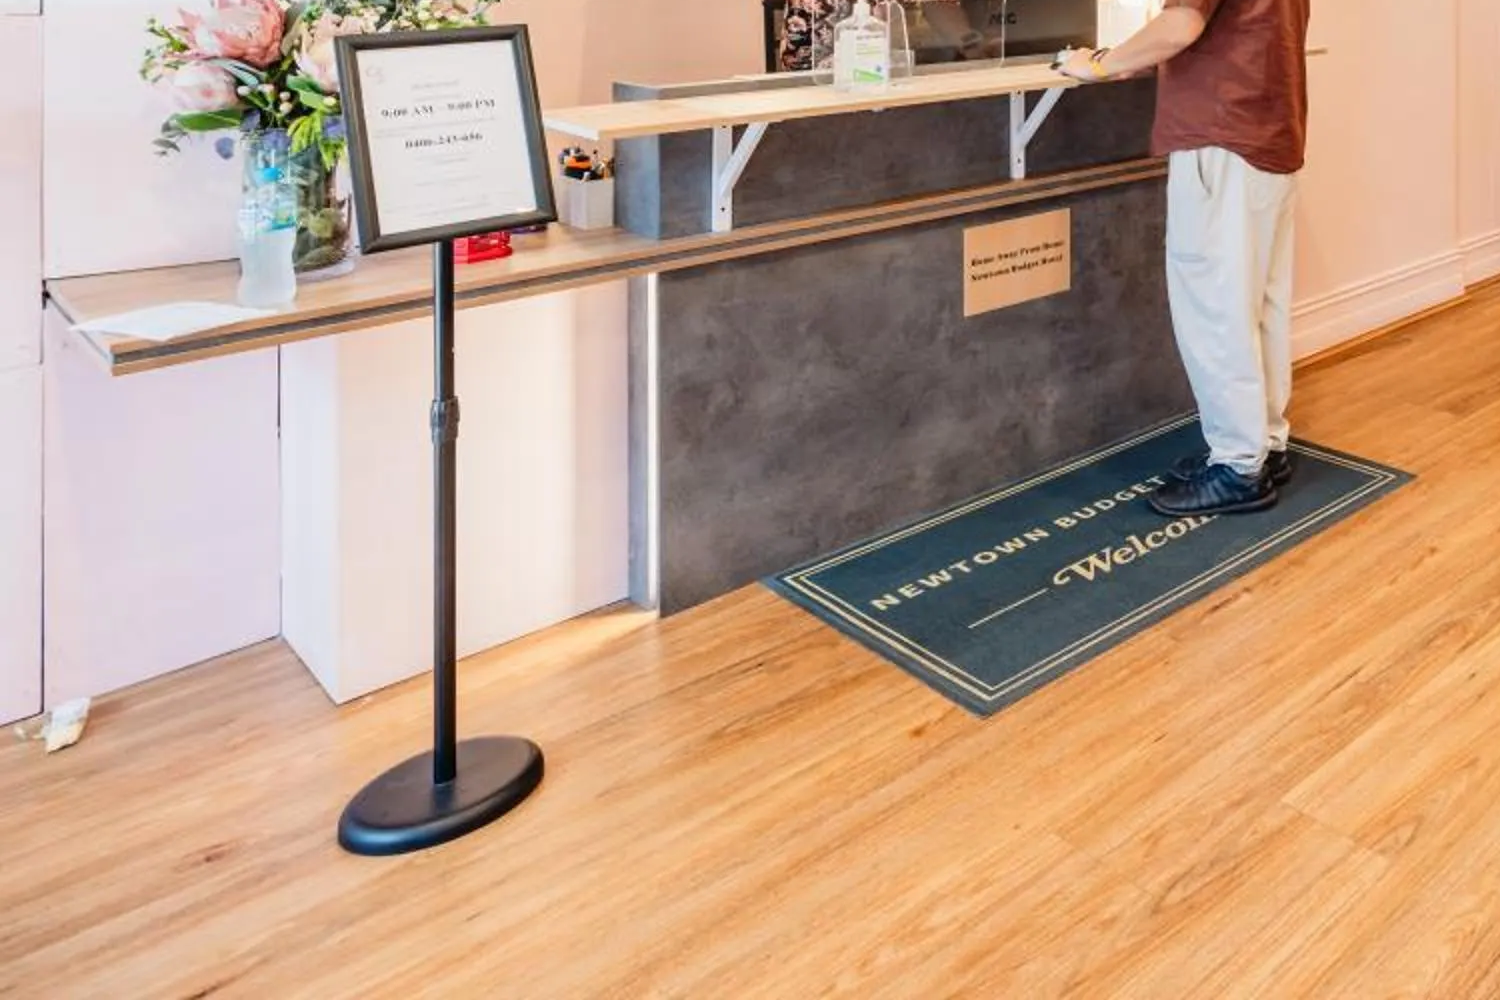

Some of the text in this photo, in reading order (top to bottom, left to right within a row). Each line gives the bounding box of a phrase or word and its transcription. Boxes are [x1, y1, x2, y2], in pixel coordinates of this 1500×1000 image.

[871, 475, 1166, 612] NEWTOWN BUDGET
[1053, 513, 1219, 586] Welco
